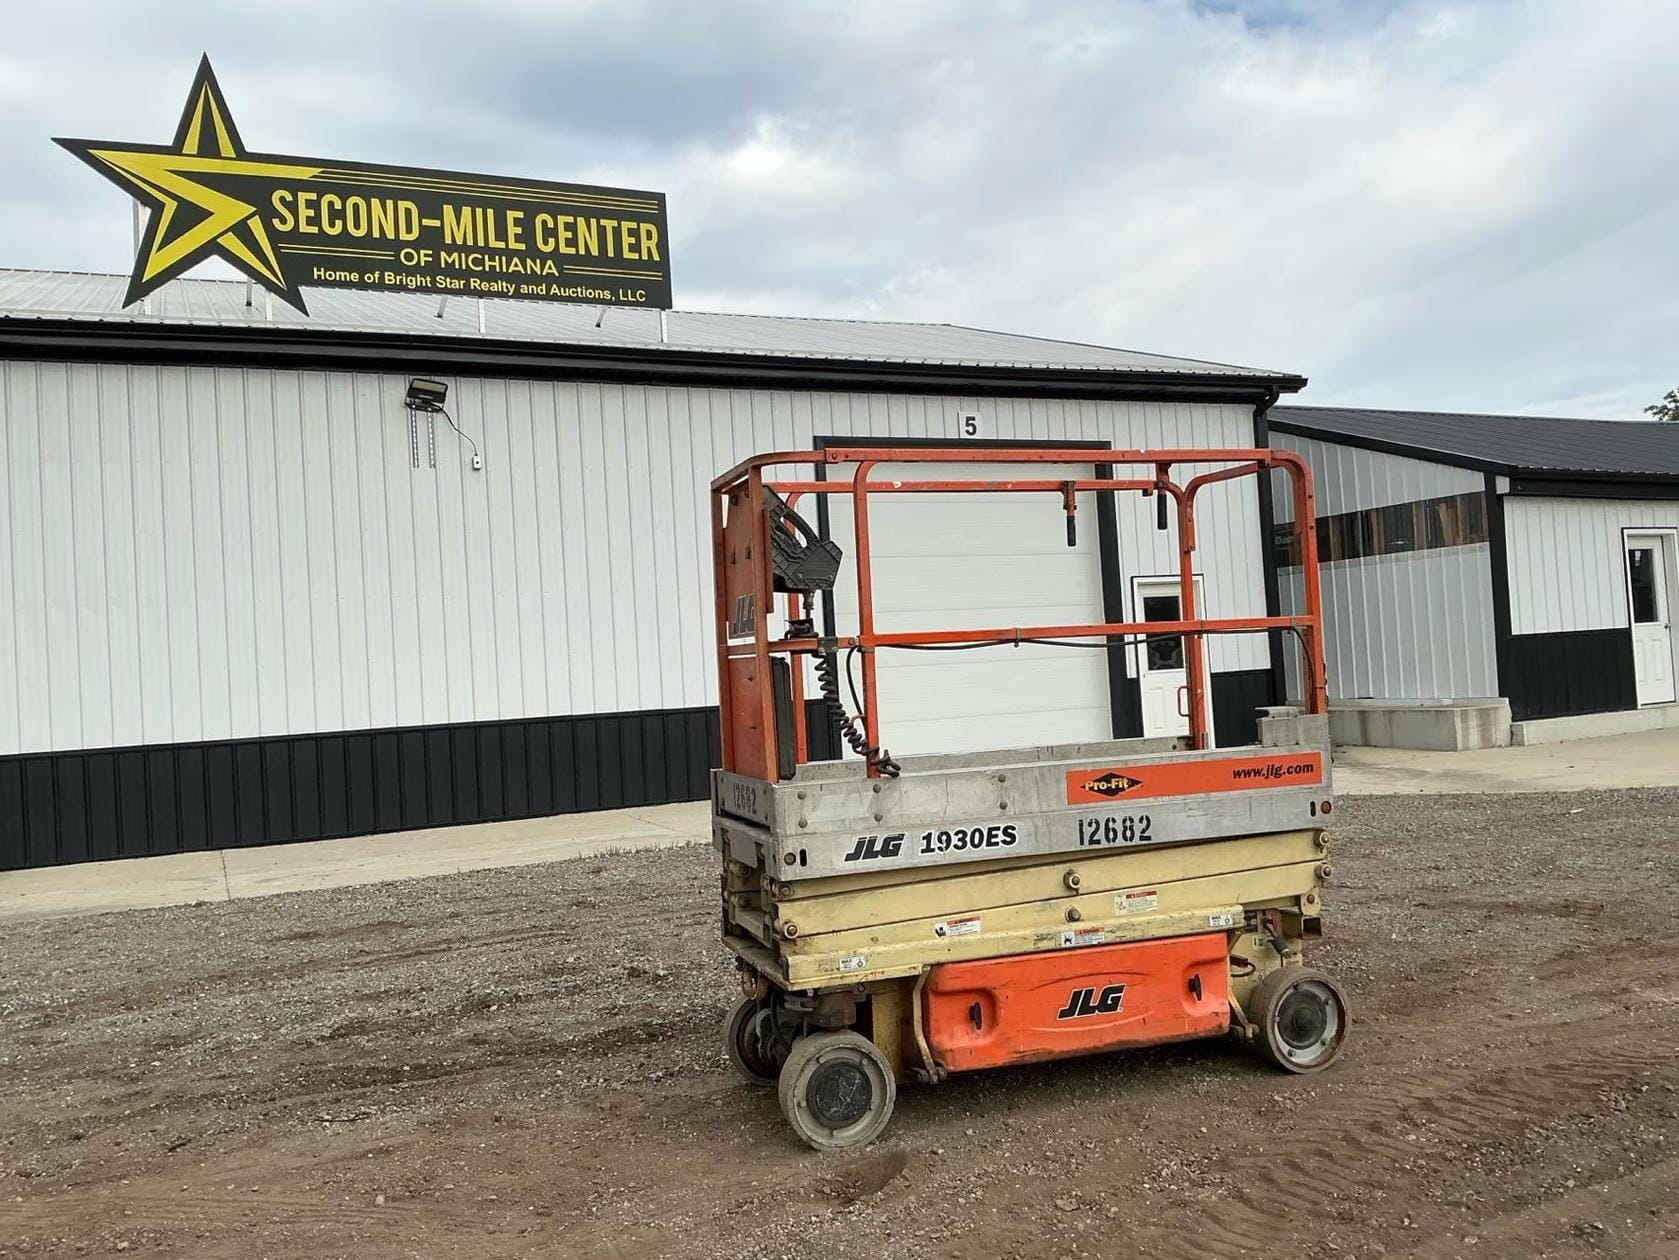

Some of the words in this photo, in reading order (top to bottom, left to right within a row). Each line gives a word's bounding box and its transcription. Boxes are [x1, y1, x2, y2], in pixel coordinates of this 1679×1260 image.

[271, 189, 526, 251] SECOND-MILE
[535, 213, 661, 262] CENTER
[400, 247, 433, 267] OF
[440, 252, 559, 277] MICHIANA
[313, 267, 360, 284] Home
[364, 269, 380, 284] of
[384, 272, 432, 289] Bright
[435, 275, 466, 290] Star
[470, 277, 517, 297] Realty
[520, 282, 546, 295] and
[550, 284, 615, 301] Auctions,
[619, 289, 647, 302] LLC
[965, 415, 977, 436] 5
[1232, 763, 1314, 779] www.jlg.com
[844, 833, 905, 862] JLG
[920, 825, 1018, 853] 1930ES
[1078, 815, 1152, 846] 12682
[1057, 983, 1126, 1020] JLG
